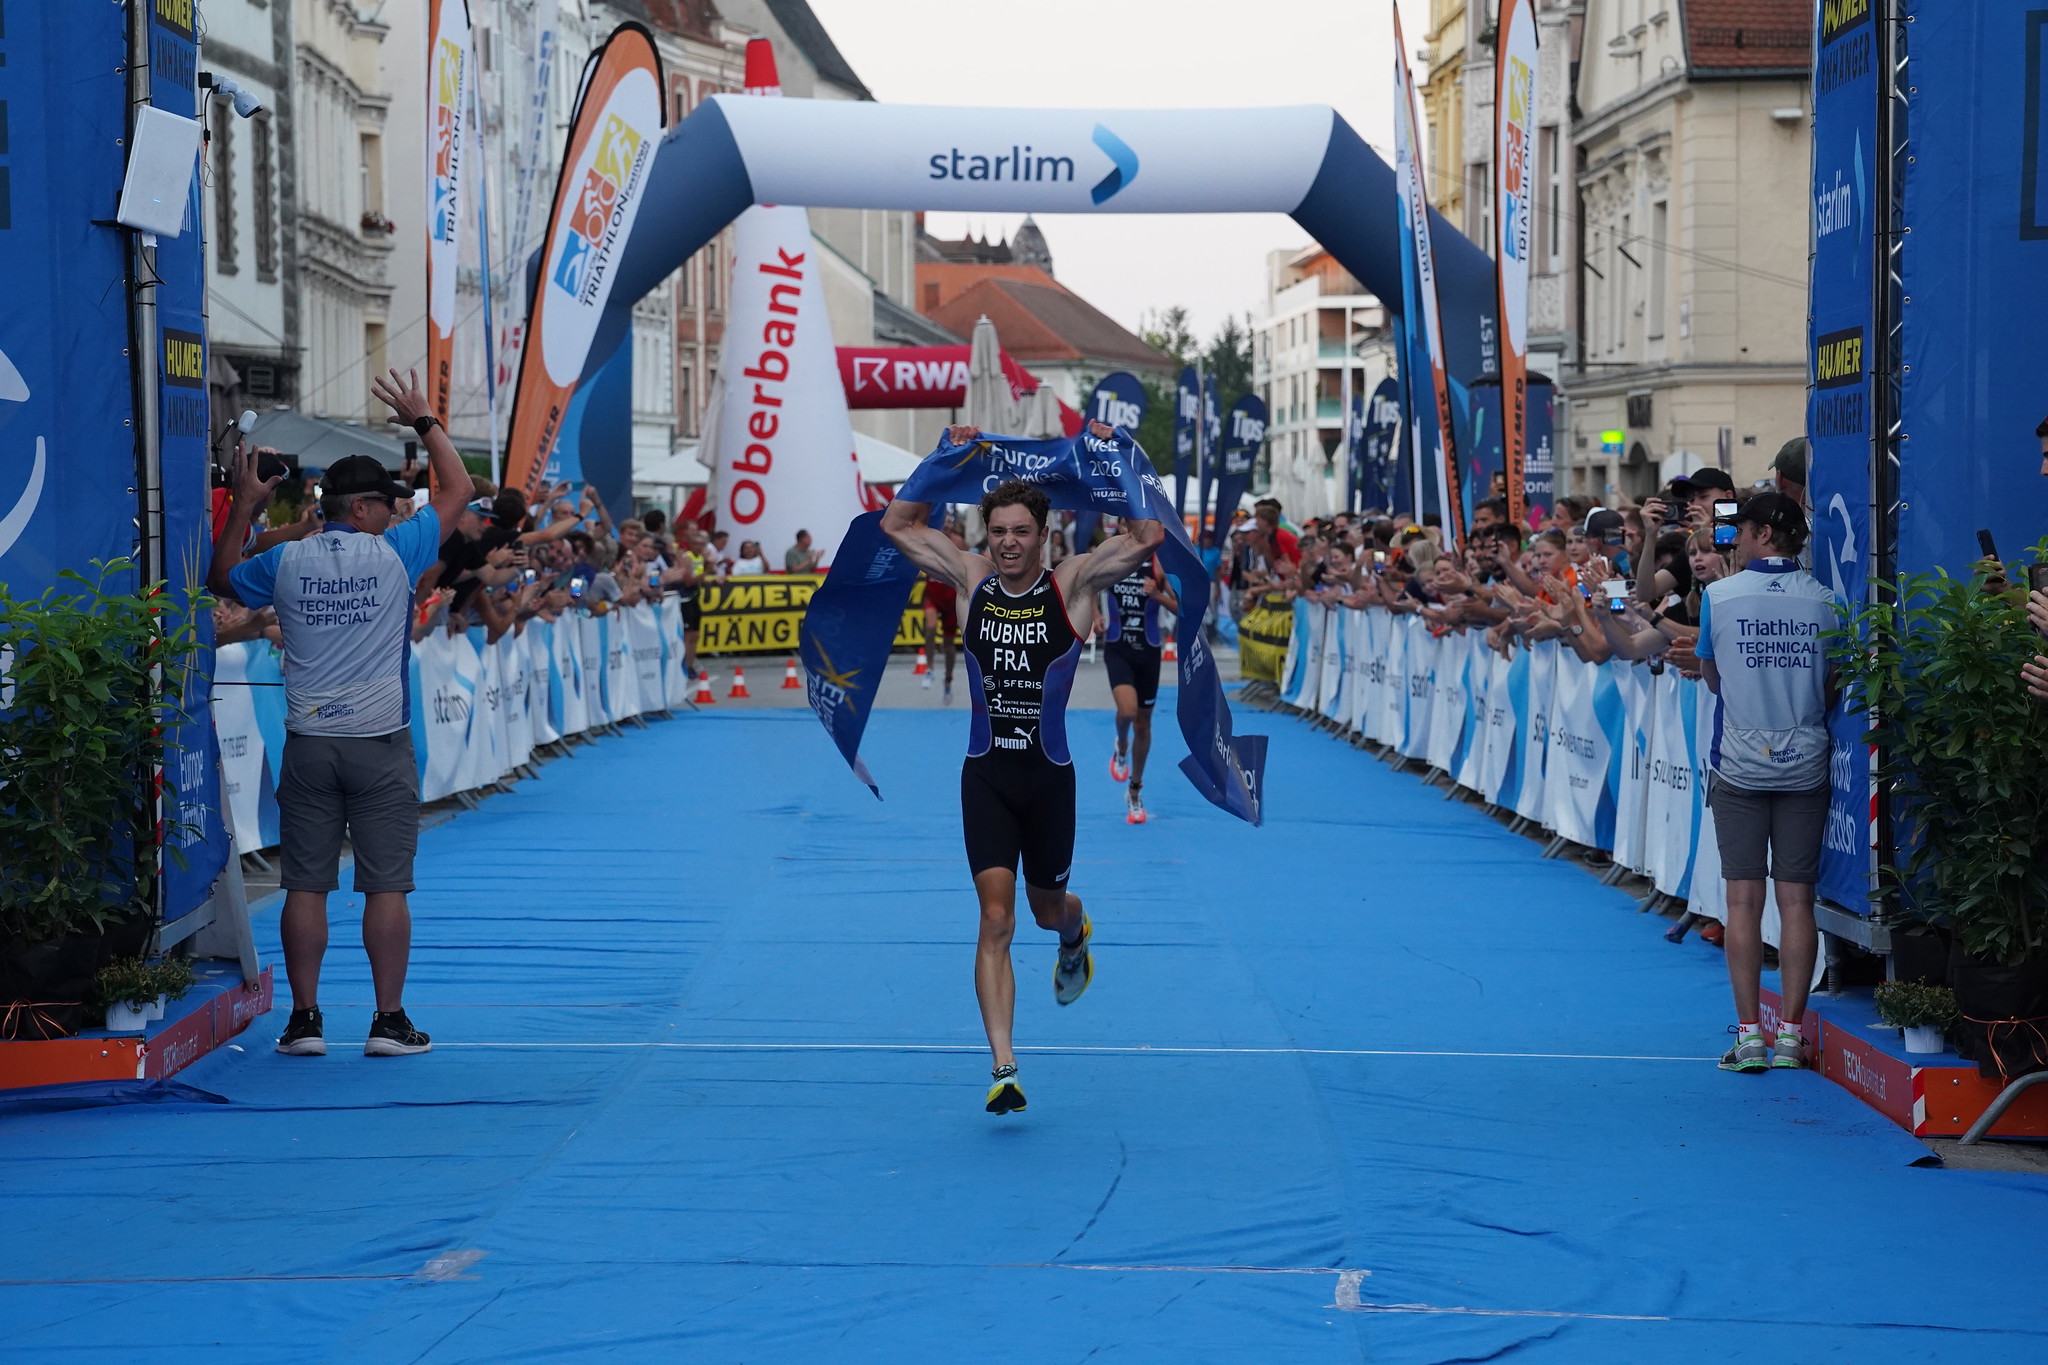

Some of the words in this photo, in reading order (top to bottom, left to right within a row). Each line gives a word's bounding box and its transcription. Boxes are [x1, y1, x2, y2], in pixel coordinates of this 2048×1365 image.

[929, 146, 1074, 182] starlim
[1818, 169, 1851, 238] starlim
[582, 194, 629, 308] TRIATHLON
[167, 339, 203, 378] HUMER
[1817, 337, 1861, 381] HUMER
[730, 247, 805, 525] Oberbank
[1096, 389, 1141, 430] Tips
[1233, 409, 1265, 446] Tips
[526, 405, 560, 491] HUMER
[300, 576, 378, 595] Triathlon
[699, 584, 816, 612] UMER
[297, 595, 380, 612] TECHNICAL
[983, 602, 1044, 619] POISSY
[1122, 595, 1140, 607] FRA
[306, 611, 372, 626] OFFICIAL
[980, 618, 1049, 644] HUBNER
[1736, 619, 1820, 636] Triathlon
[703, 617, 792, 647] HÄNG
[993, 648, 1031, 671] FRA
[1736, 642, 1819, 654] TECHNICAL
[1746, 656, 1811, 668] OFFICIAL
[995, 736, 1027, 750] PUMA
[1769, 748, 1796, 757] Europe
[180, 745, 204, 795] Europe
[1770, 753, 1804, 763] Triathlon
